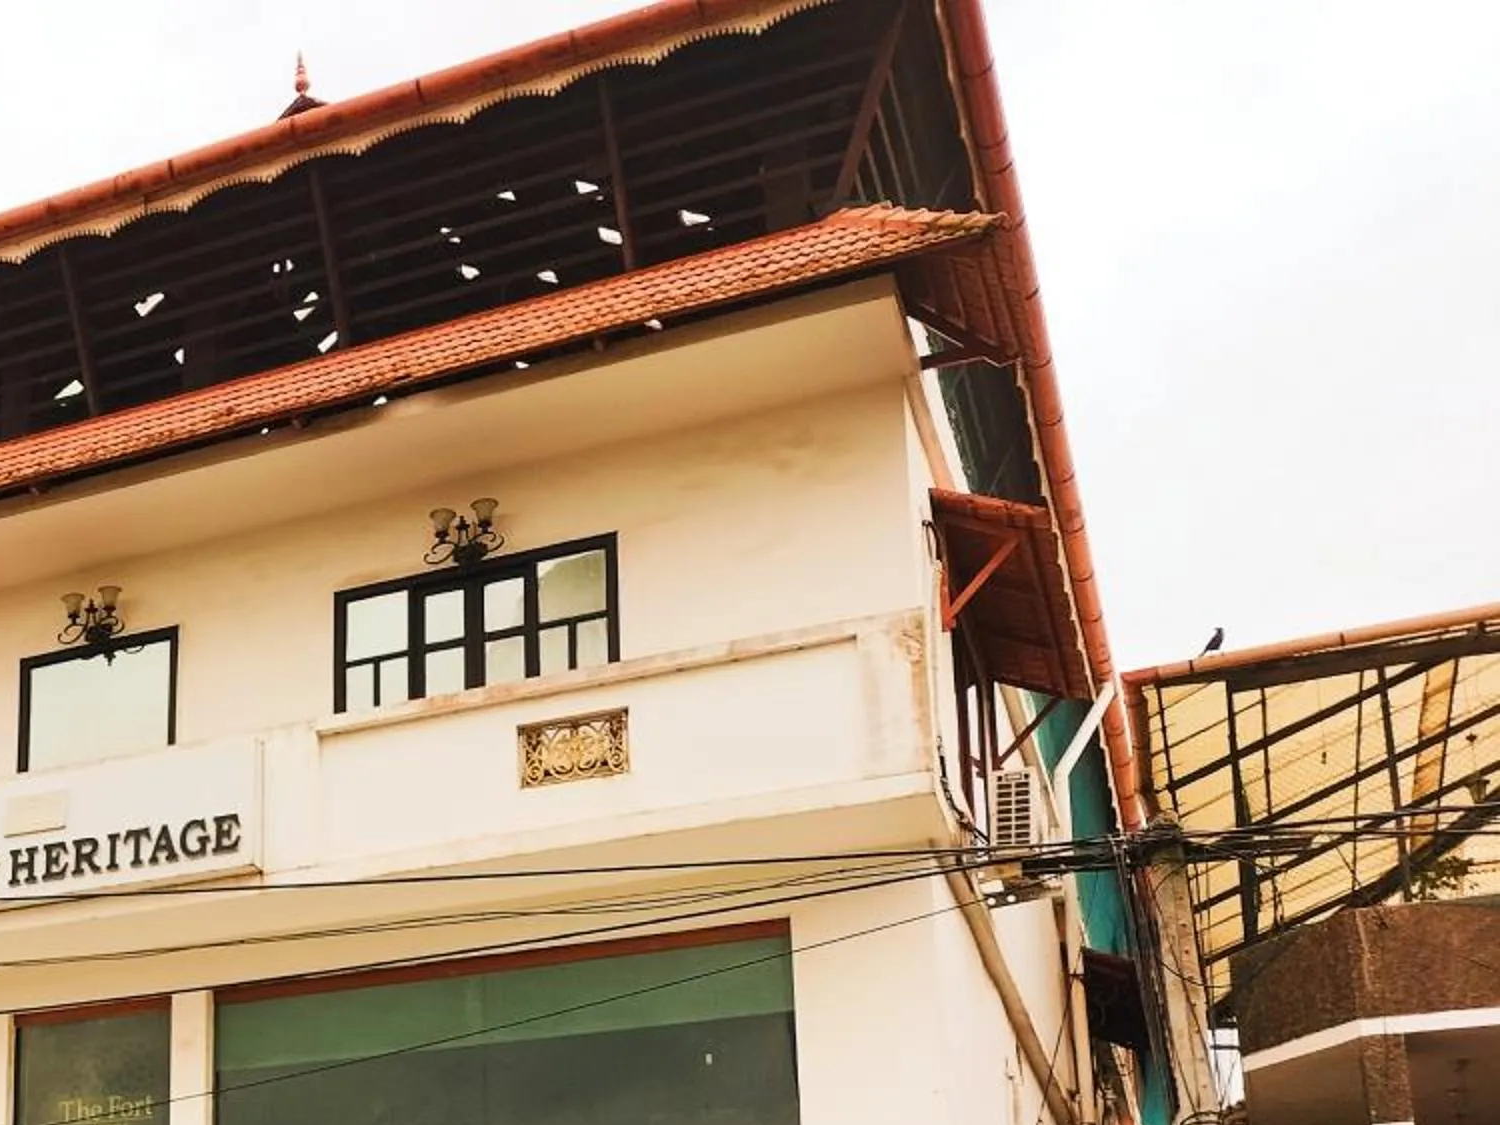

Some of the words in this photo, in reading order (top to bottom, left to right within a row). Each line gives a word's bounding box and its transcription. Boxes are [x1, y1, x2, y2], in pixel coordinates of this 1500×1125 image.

[8, 813, 242, 886] HERITAGE
[58, 1098, 103, 1122] The
[108, 1094, 153, 1119] Fort
